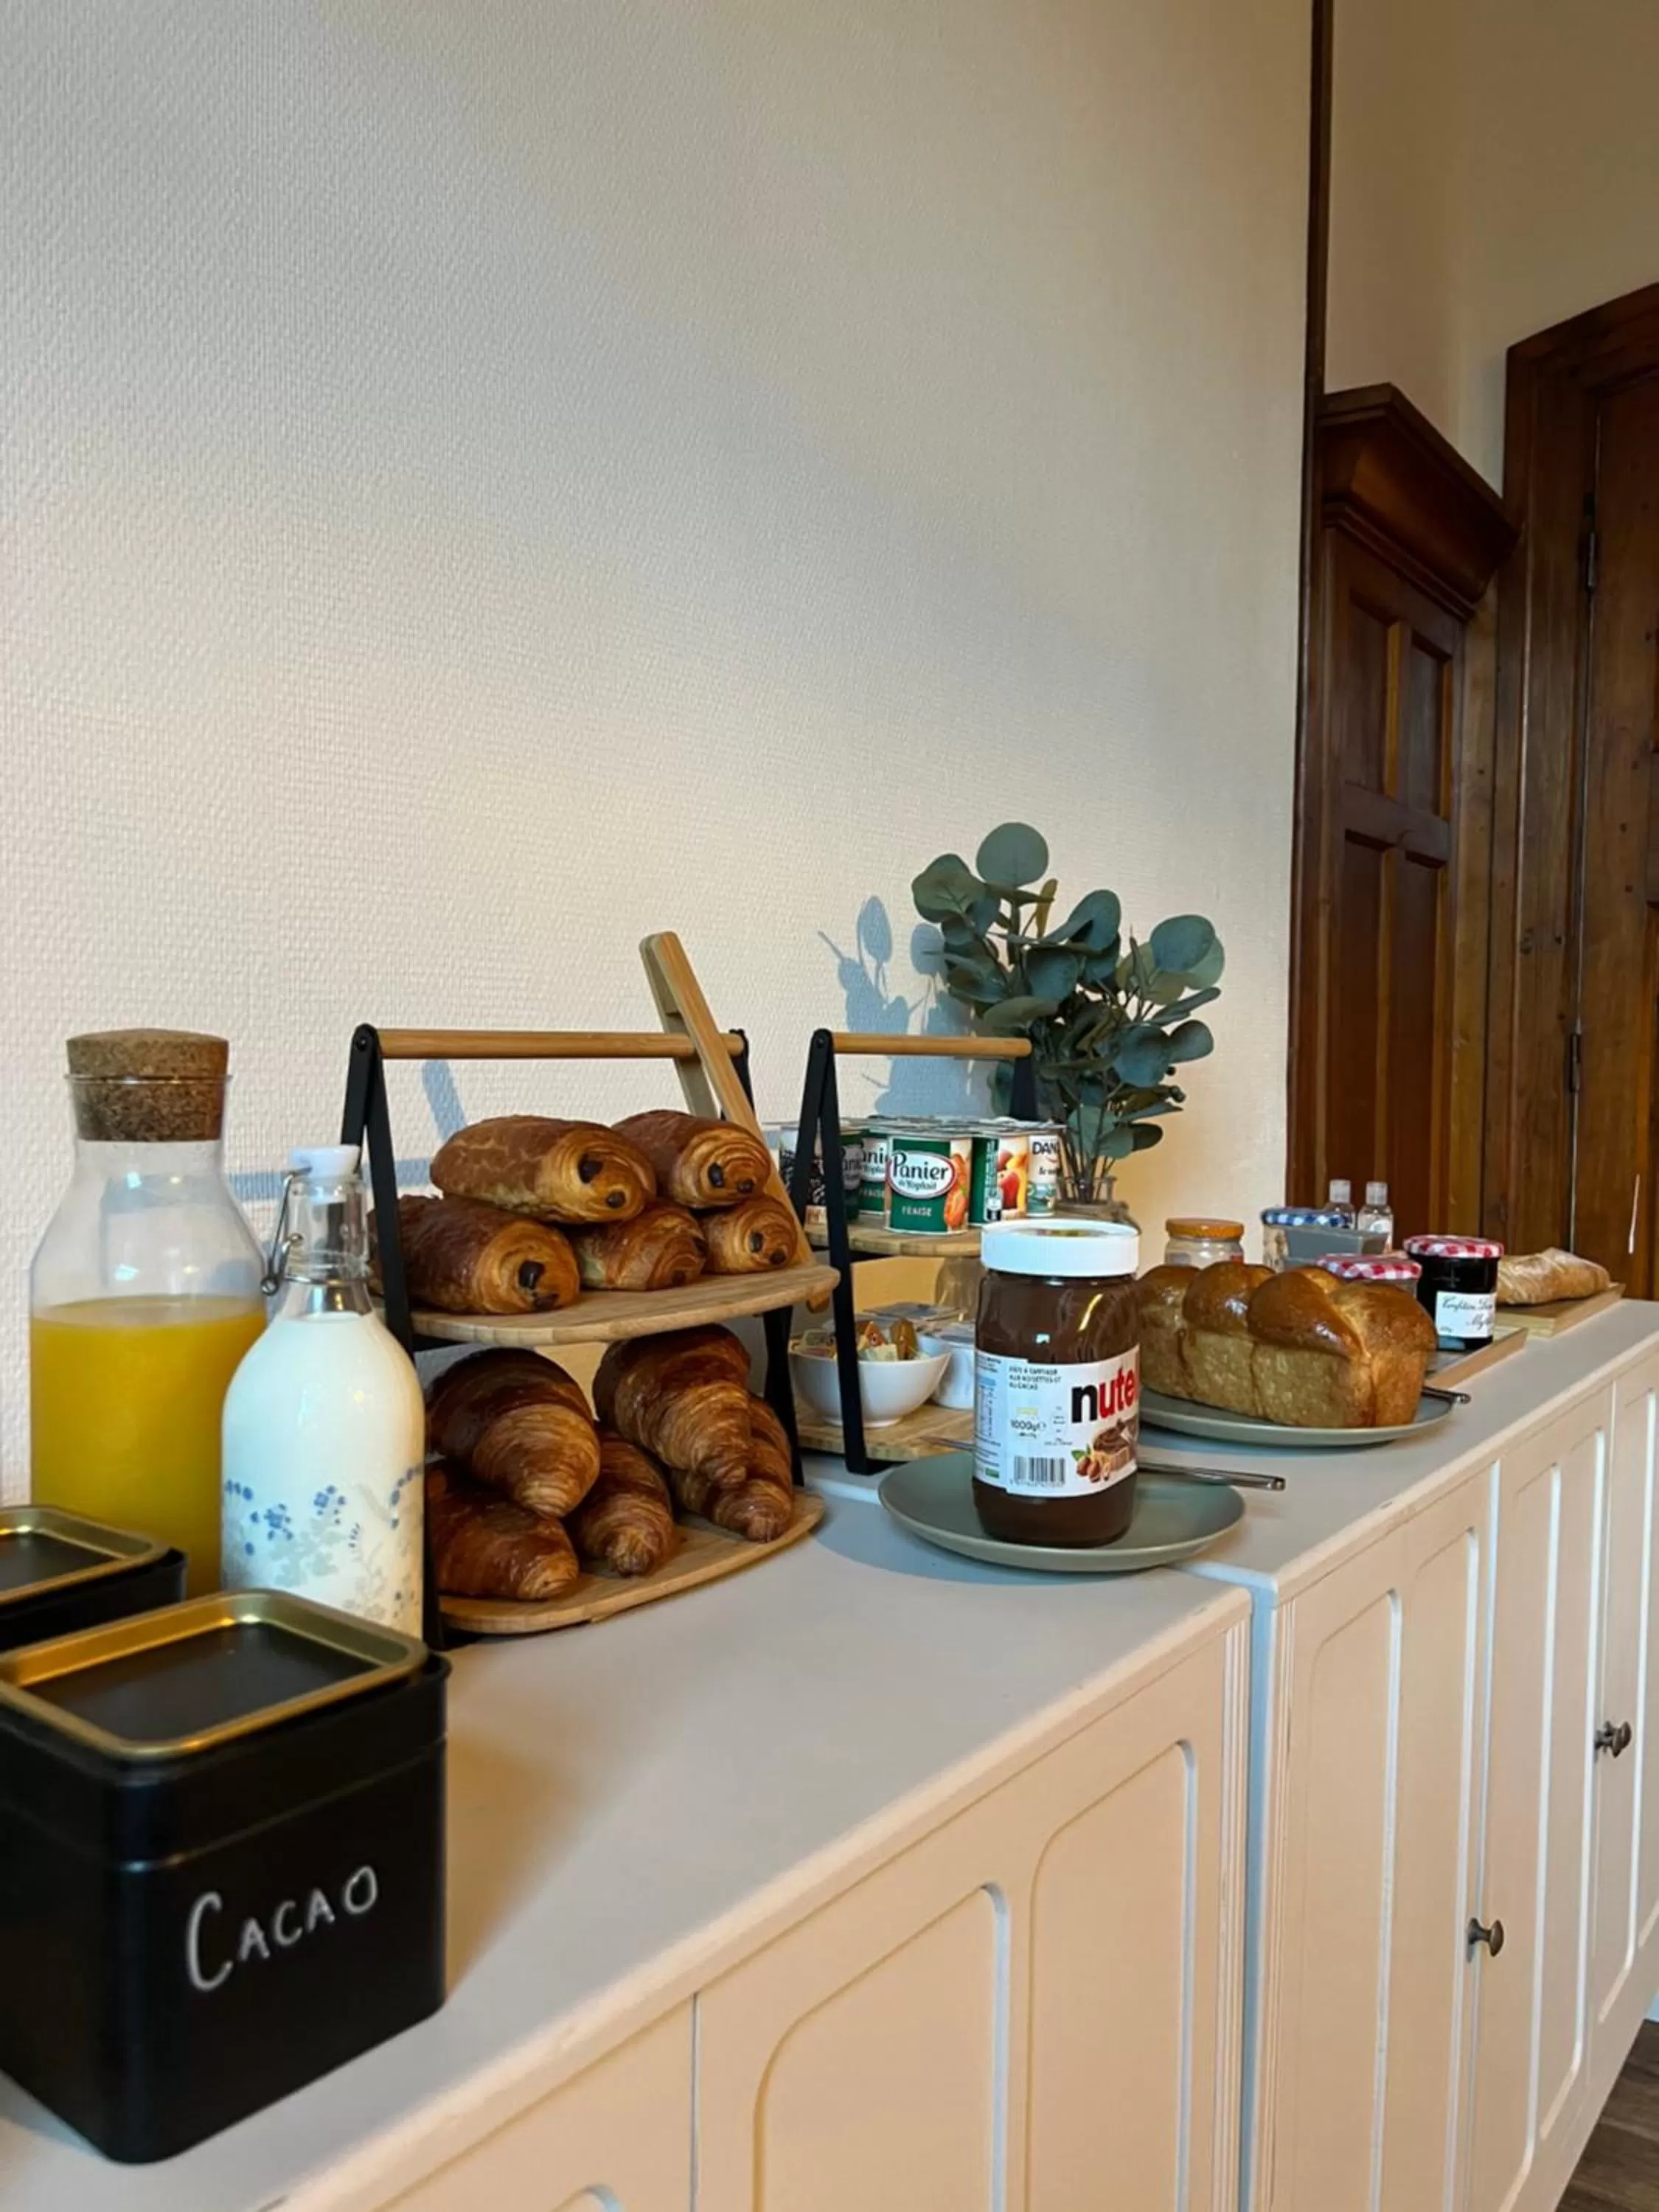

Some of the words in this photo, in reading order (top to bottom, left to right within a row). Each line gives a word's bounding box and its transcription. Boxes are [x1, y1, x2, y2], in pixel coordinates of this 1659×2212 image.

[893, 1152, 949, 1180] Panier
[907, 1180, 937, 1192] Yoplait
[902, 1206, 933, 1217] FRAISE
[1071, 1366, 1138, 1423] nute
[187, 1865, 378, 1990] CACAO
